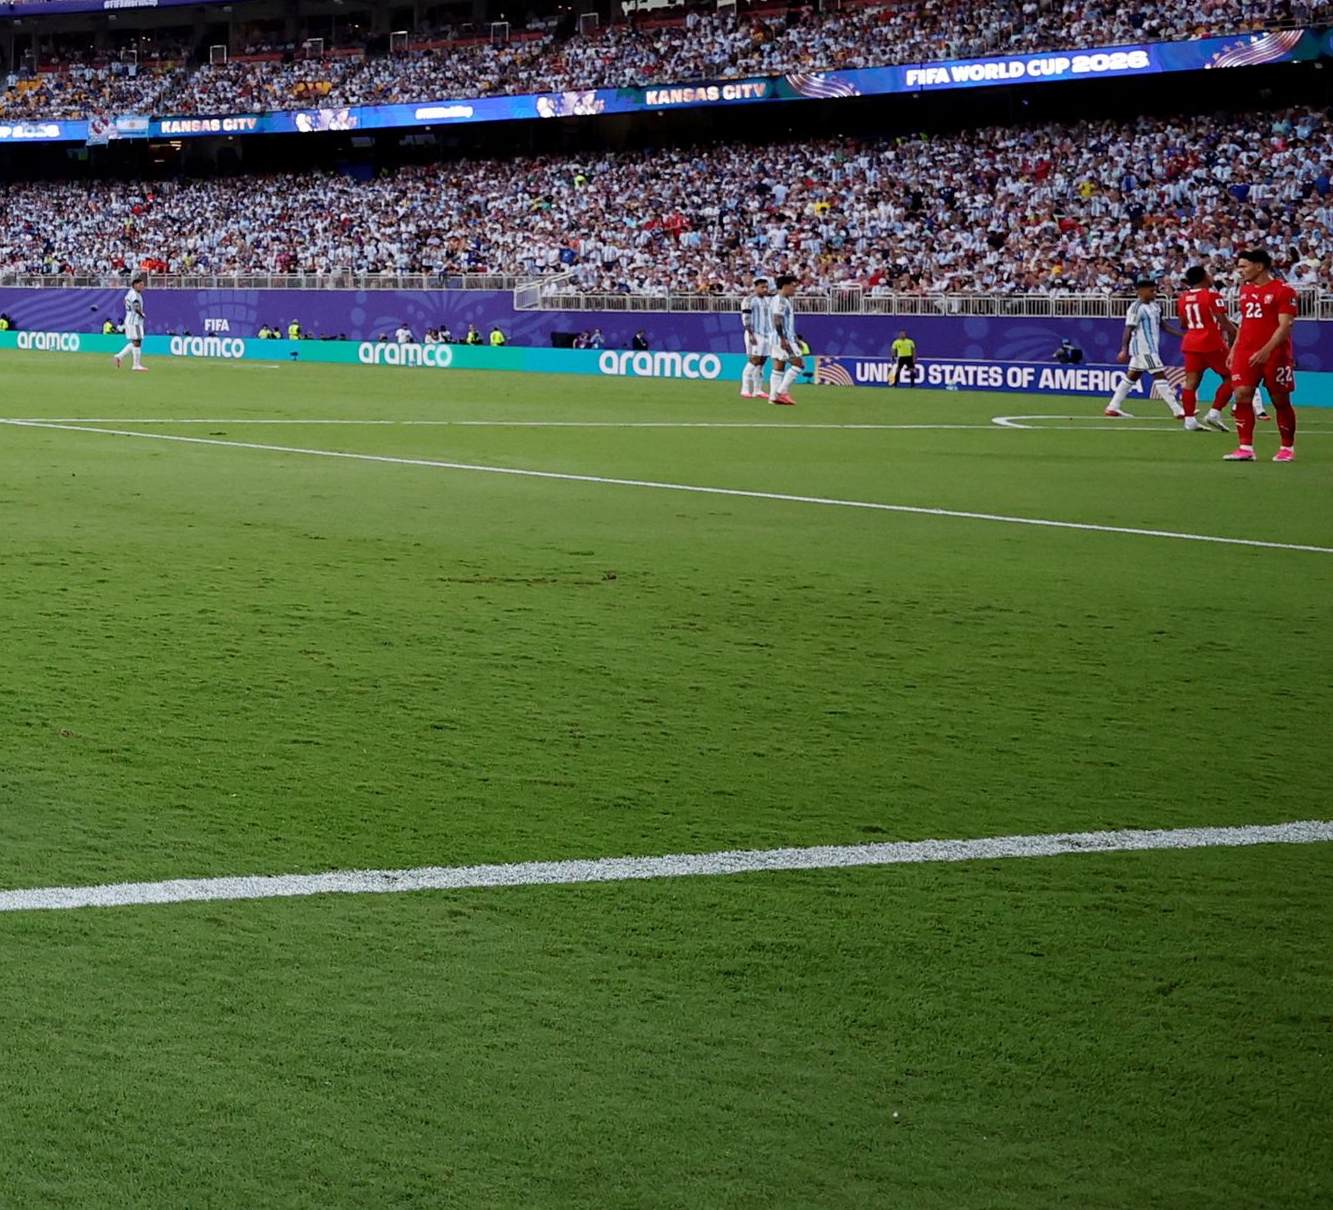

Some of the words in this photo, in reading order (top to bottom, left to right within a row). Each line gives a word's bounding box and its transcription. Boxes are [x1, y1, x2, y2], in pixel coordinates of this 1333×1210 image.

[906, 67, 950, 86] FIFA
[951, 61, 1025, 82] WORLD
[1026, 57, 1070, 76] CUP
[1071, 50, 1149, 73] 2026
[646, 86, 719, 105] KANSAS
[722, 83, 766, 100] CITY
[161, 119, 220, 134] KANSAS
[222, 118, 258, 131] CITY
[1184, 303, 1204, 329] 11
[1245, 302, 1263, 318] 22
[204, 318, 229, 332] FIFA
[17, 331, 80, 352] aramco
[170, 336, 245, 359] aramco
[358, 342, 452, 367] aramco
[599, 350, 721, 379] aramco
[855, 362, 924, 384] UNIED
[928, 364, 1003, 387] STATES
[1007, 367, 1035, 387] OF
[1038, 369, 1144, 393] AMERICA
[1276, 365, 1293, 382] 22
